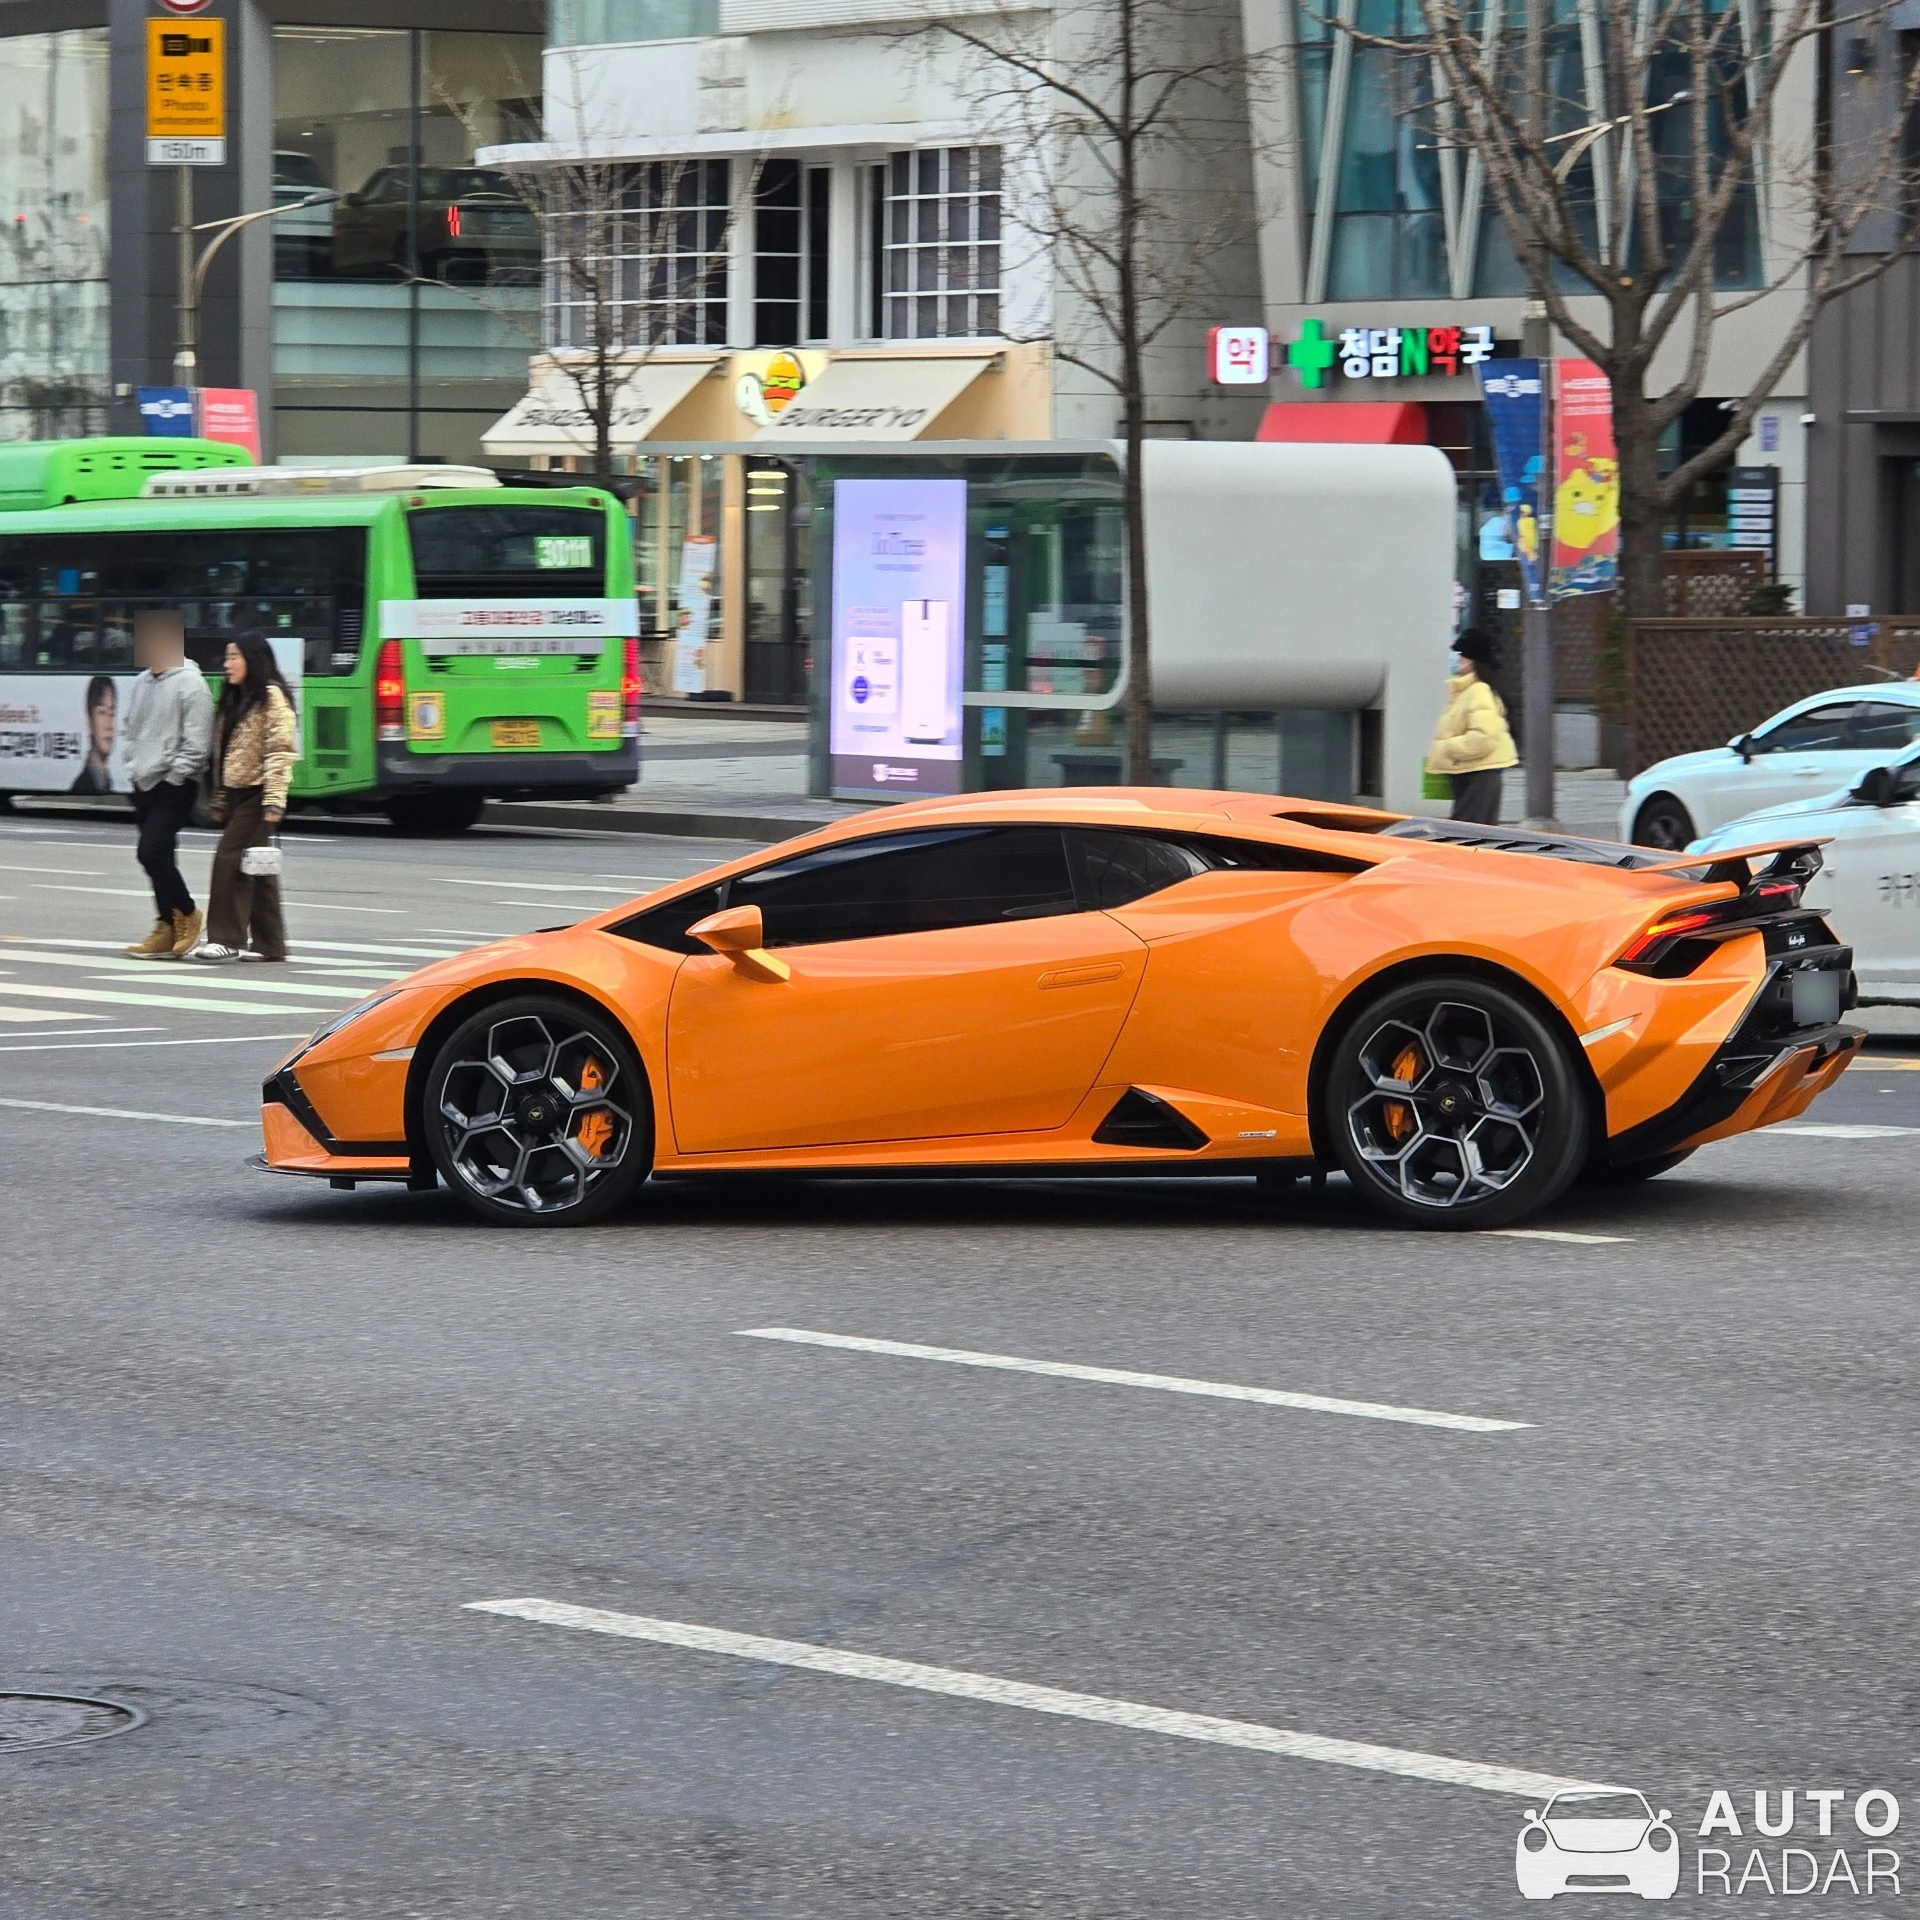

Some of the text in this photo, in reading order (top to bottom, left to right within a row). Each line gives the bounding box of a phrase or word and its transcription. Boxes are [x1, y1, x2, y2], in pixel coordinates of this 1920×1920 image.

[1228, 336, 1258, 376] 약
[1338, 325, 1495, 378] 청담N약국
[776, 406, 929, 428] BURGER'YO
[537, 539, 591, 566] 3011
